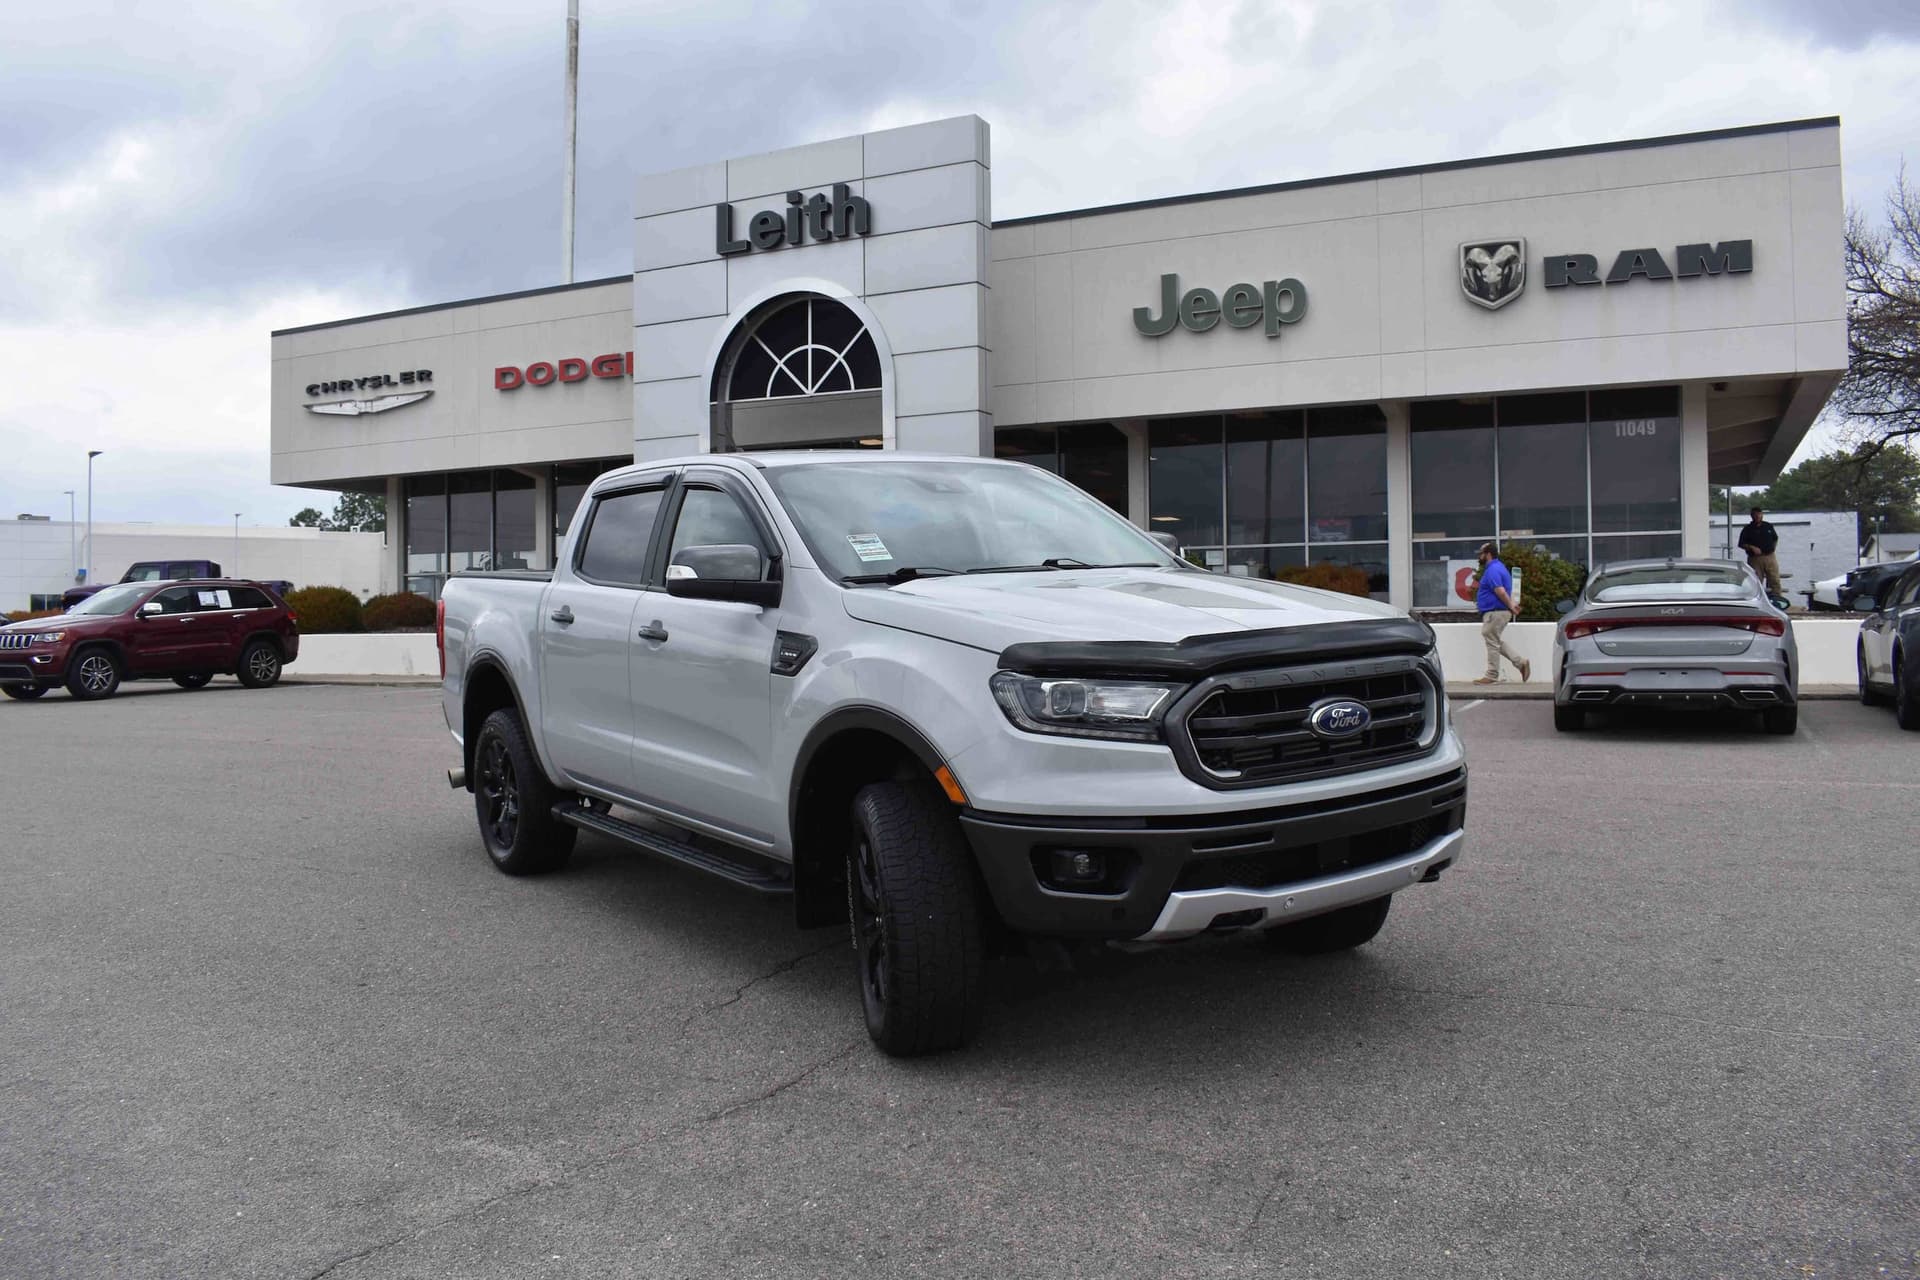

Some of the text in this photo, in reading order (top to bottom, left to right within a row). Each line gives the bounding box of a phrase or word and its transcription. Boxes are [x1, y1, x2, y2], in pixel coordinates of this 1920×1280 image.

[716, 183, 871, 256] Leith
[1544, 239, 1753, 288] RAM
[1132, 273, 1307, 337] Jeep
[305, 369, 433, 397] CHRYSLER
[494, 351, 633, 391] DODG
[1615, 419, 1656, 437] 11049
[1243, 659, 1410, 688] RANGER
[1329, 707, 1361, 729] Ford
